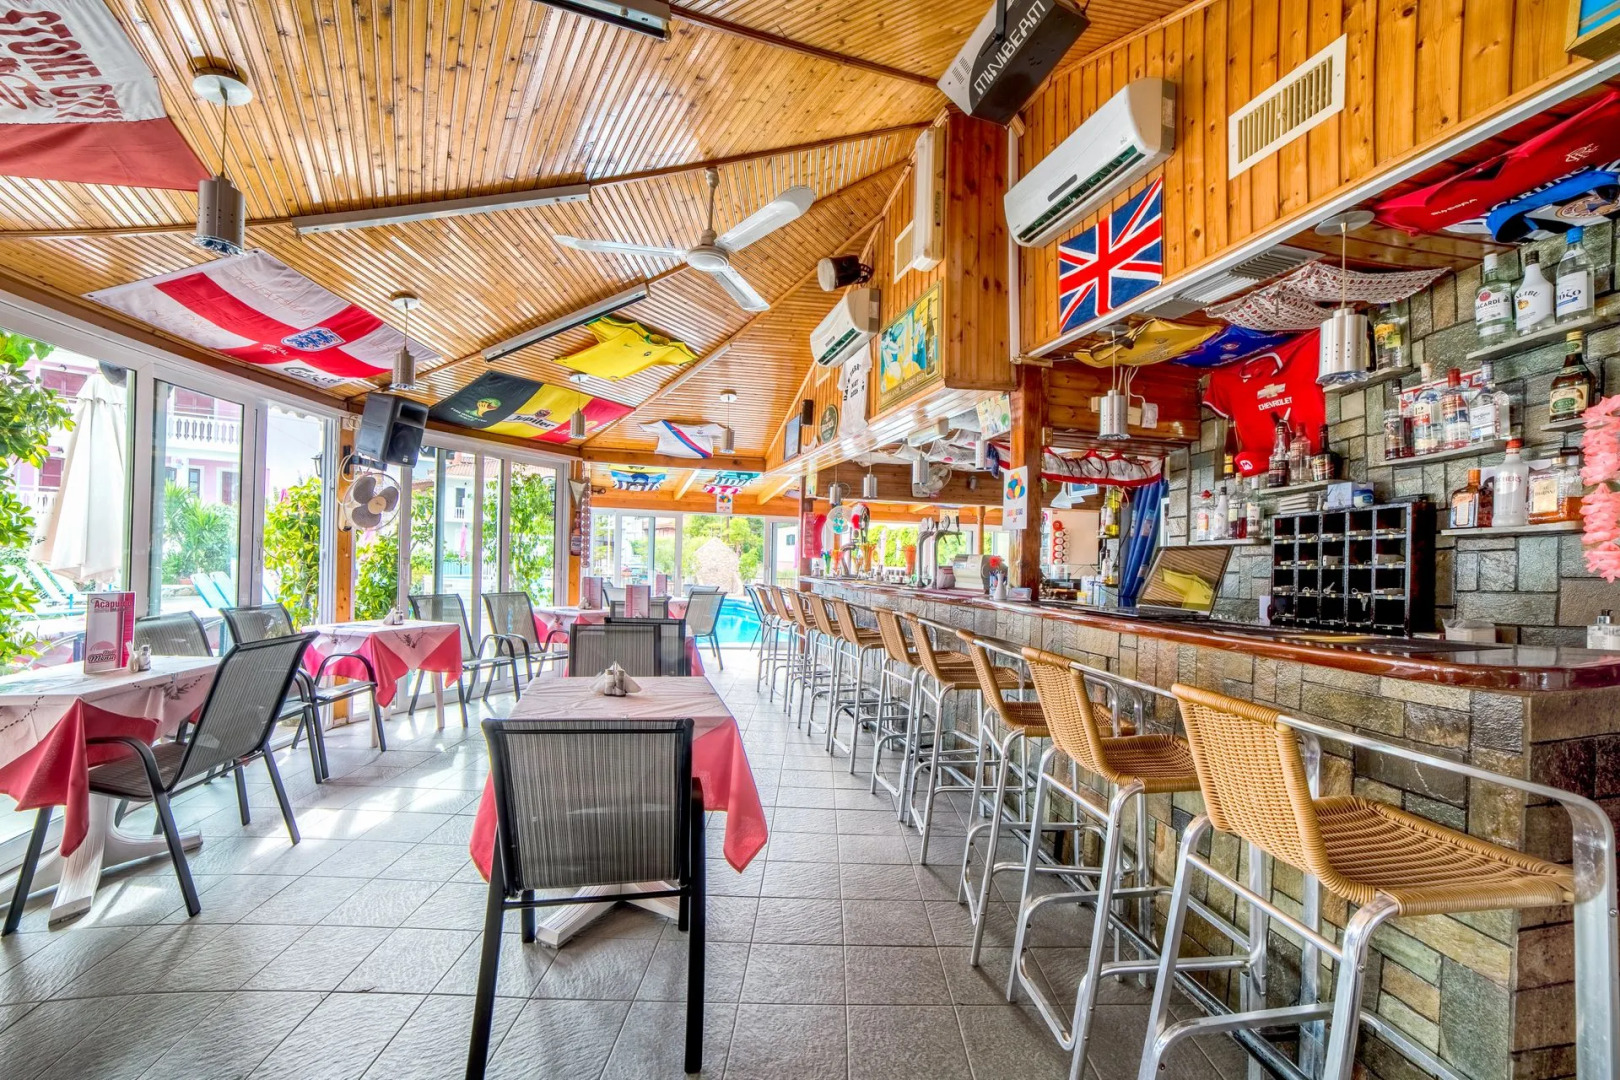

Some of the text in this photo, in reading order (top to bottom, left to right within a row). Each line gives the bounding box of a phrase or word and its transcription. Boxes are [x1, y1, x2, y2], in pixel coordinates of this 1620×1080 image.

[0, 10, 123, 120] STONE CITY
[974, 0, 1046, 95] MINIBEAM
[1491, 165, 1589, 212] CARLING
[513, 415, 555, 429] Jupiler
[1258, 396, 1293, 411] CHEVROLET
